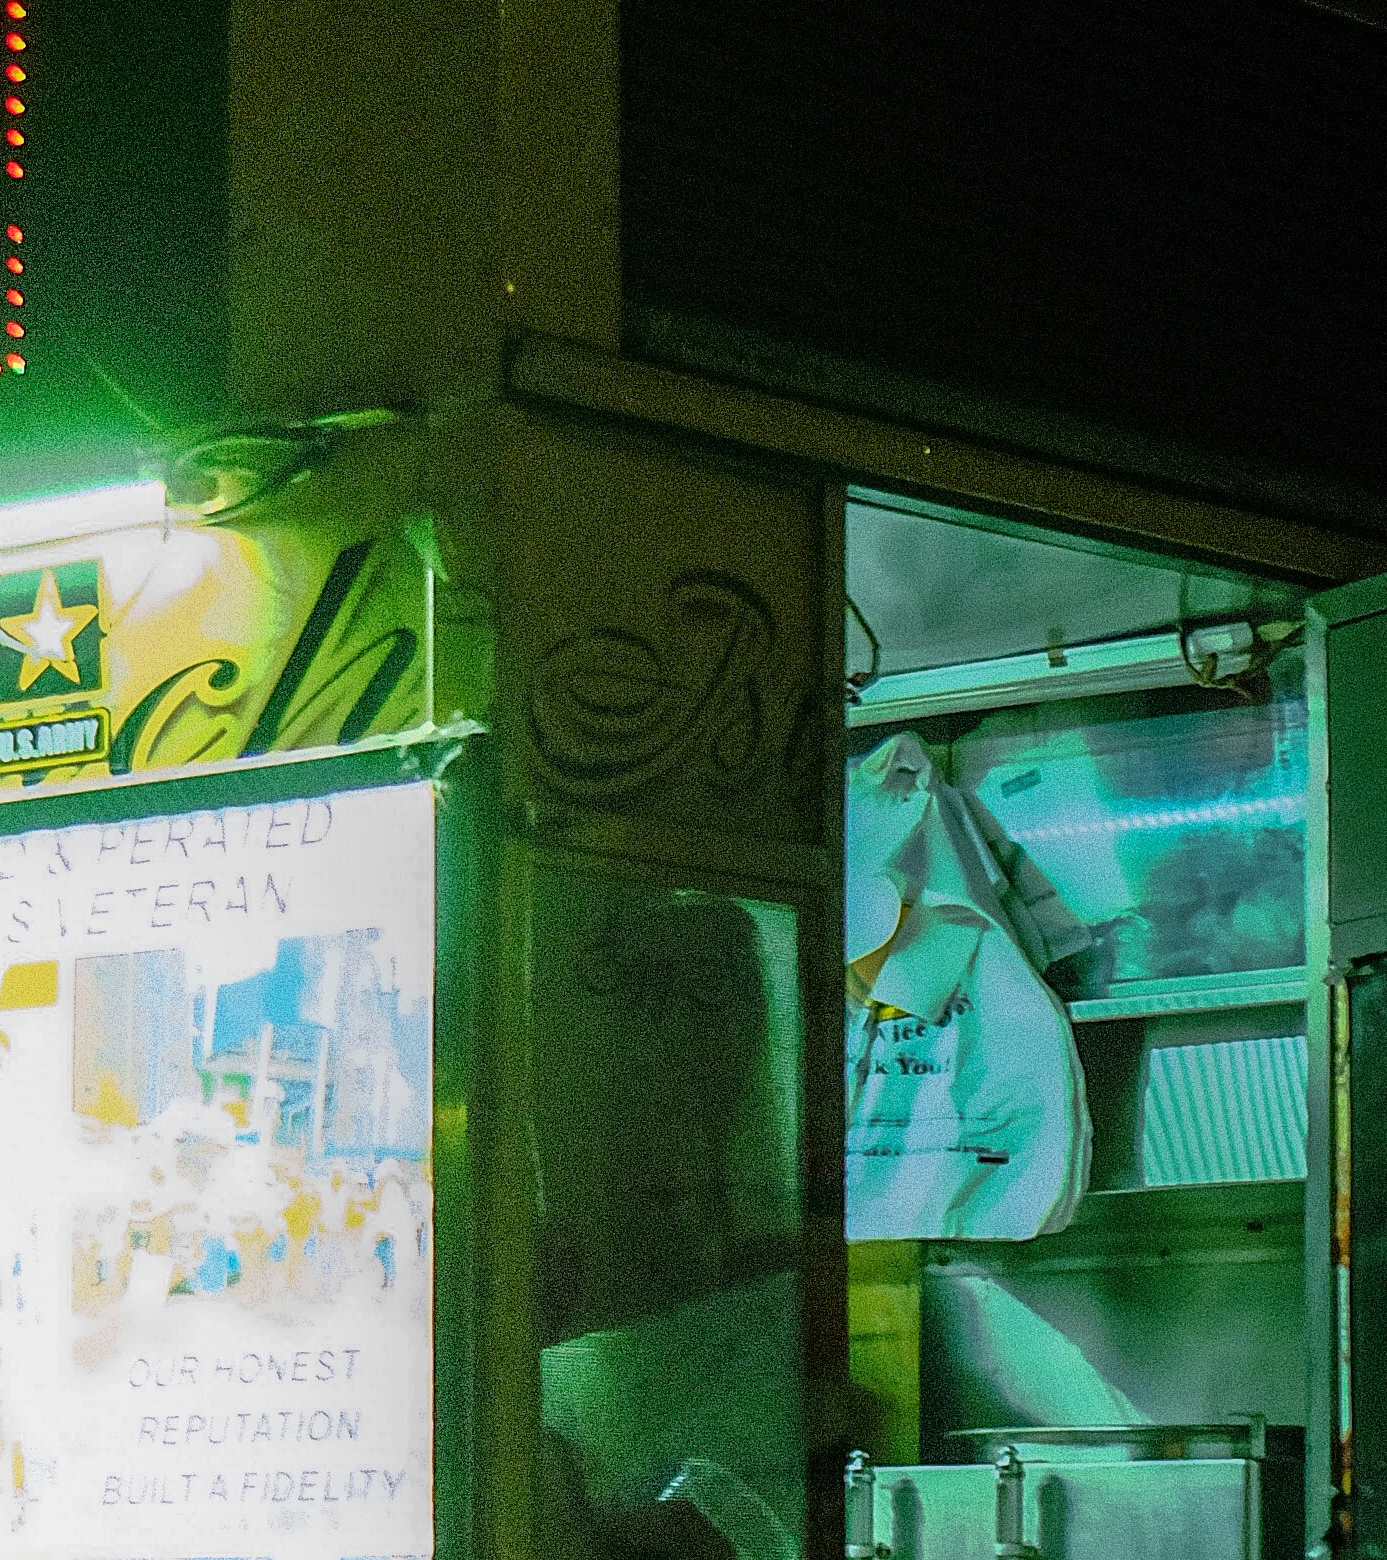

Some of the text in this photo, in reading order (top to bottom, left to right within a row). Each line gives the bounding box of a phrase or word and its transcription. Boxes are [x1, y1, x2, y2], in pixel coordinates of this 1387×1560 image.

[93, 802, 334, 870] PERATED
[127, 1348, 362, 1389] OUR HONEST
[137, 1409, 362, 1447] REPUTATION
[101, 1472, 198, 1507] BUILT
[240, 1468, 407, 1503] FIDELITY
